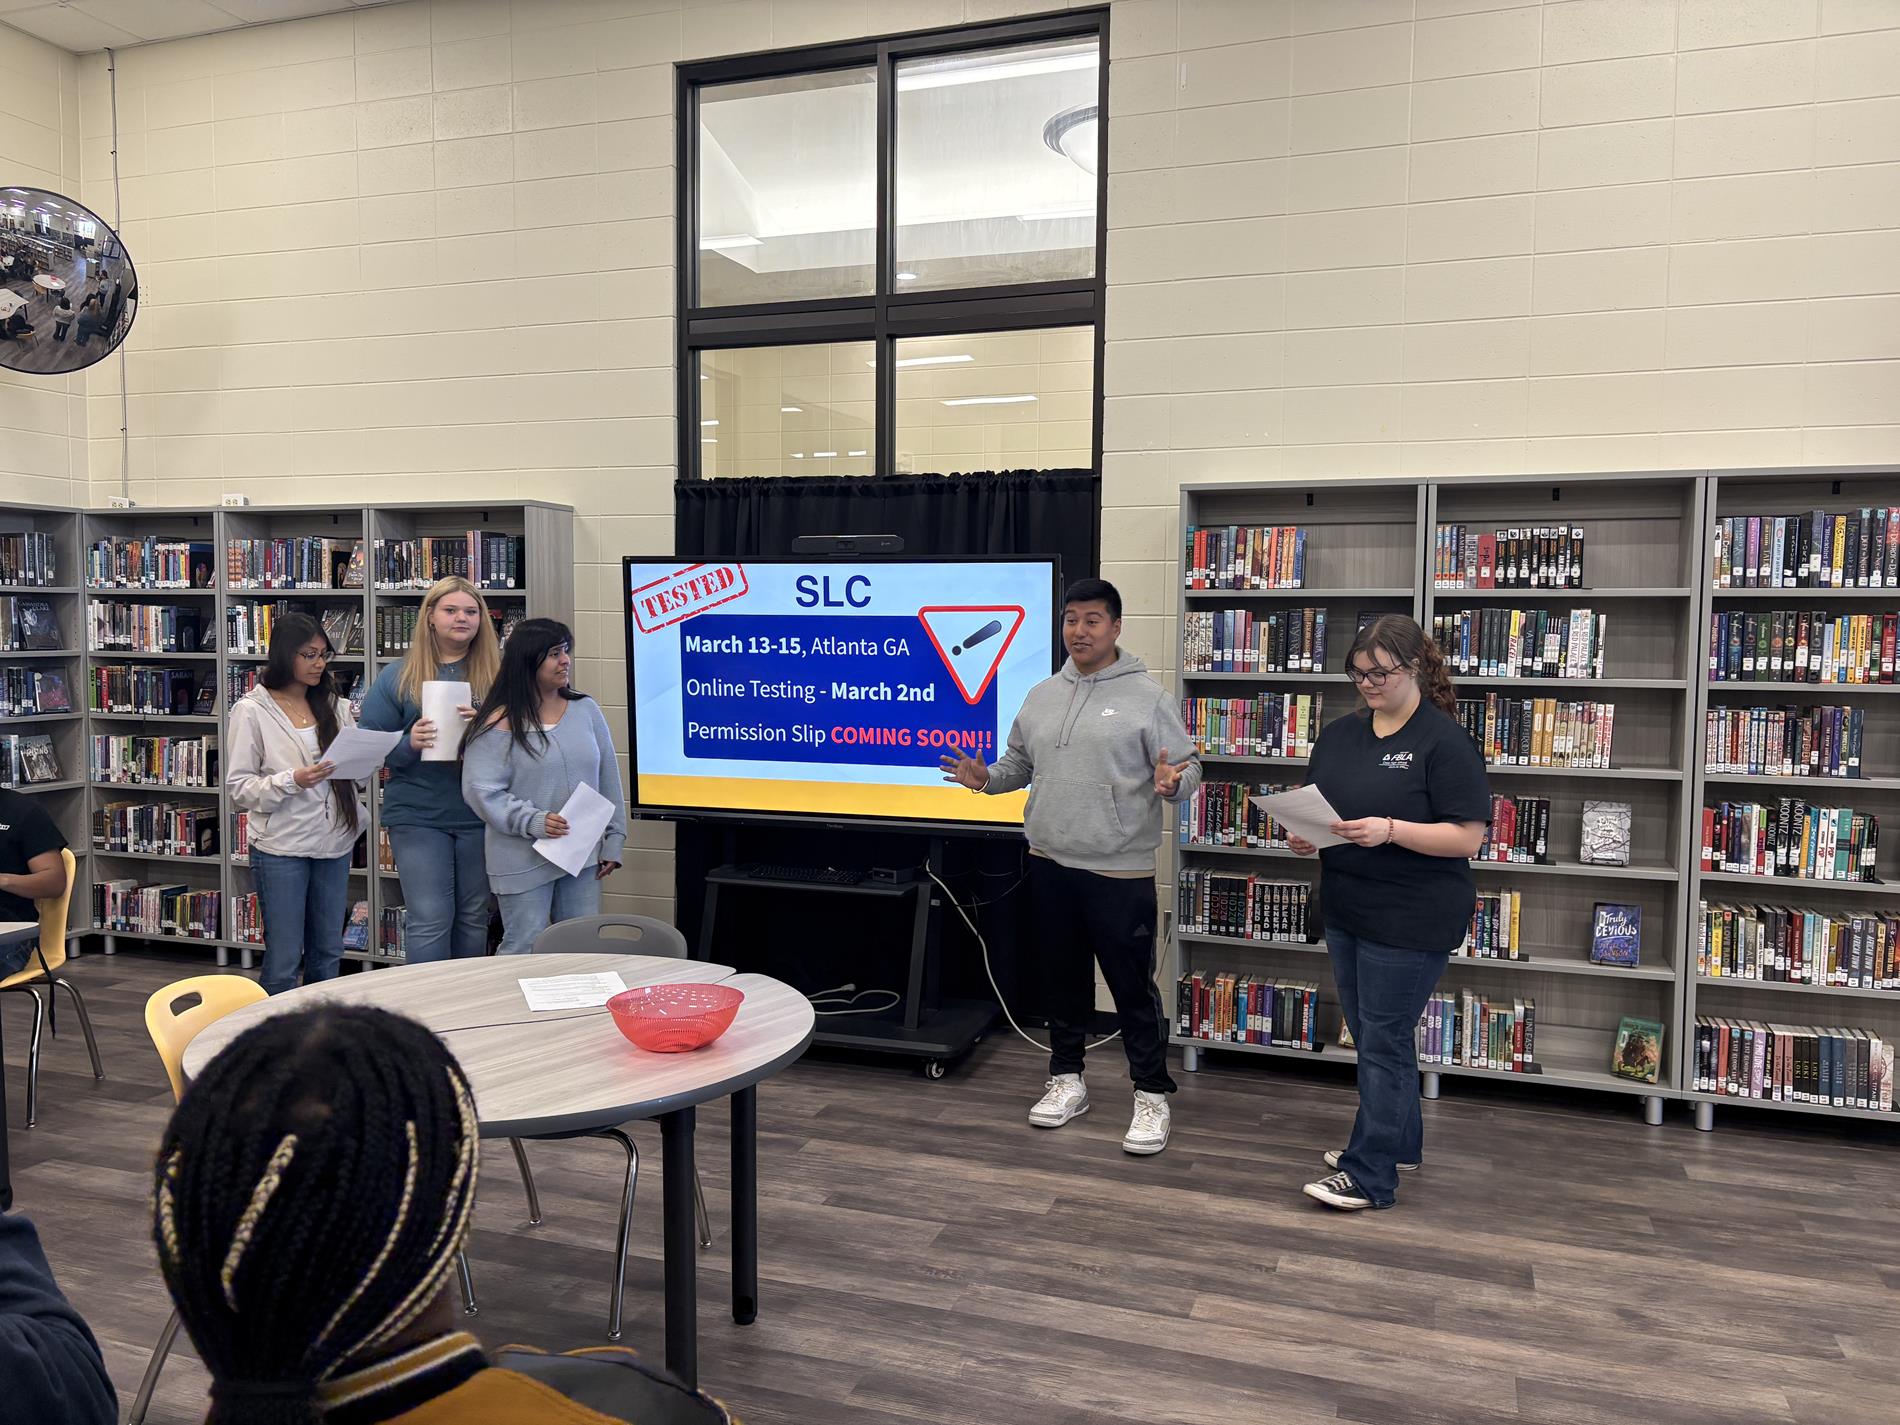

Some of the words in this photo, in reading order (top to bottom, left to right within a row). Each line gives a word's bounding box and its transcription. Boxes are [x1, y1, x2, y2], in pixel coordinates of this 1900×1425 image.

[640, 565, 735, 619] TESTED
[795, 574, 871, 608] SLC
[686, 636, 743, 654] March
[748, 637, 806, 657] 13-15,
[811, 637, 878, 656] Atlanta
[883, 638, 909, 656] GA
[687, 679, 745, 698] Online
[750, 681, 816, 704] Testing
[831, 683, 892, 701] March
[897, 683, 935, 702] 2nd
[688, 722, 786, 742] Permission
[791, 723, 826, 748] Slip
[831, 726, 912, 746] COMING
[916, 729, 991, 749] SOON!!
[1779, 803, 1790, 834] KOONTZ
[1792, 804, 1804, 834] KOONTZ
[1596, 925, 1637, 937] DEVIOUS
[1606, 912, 1626, 926] Truly
